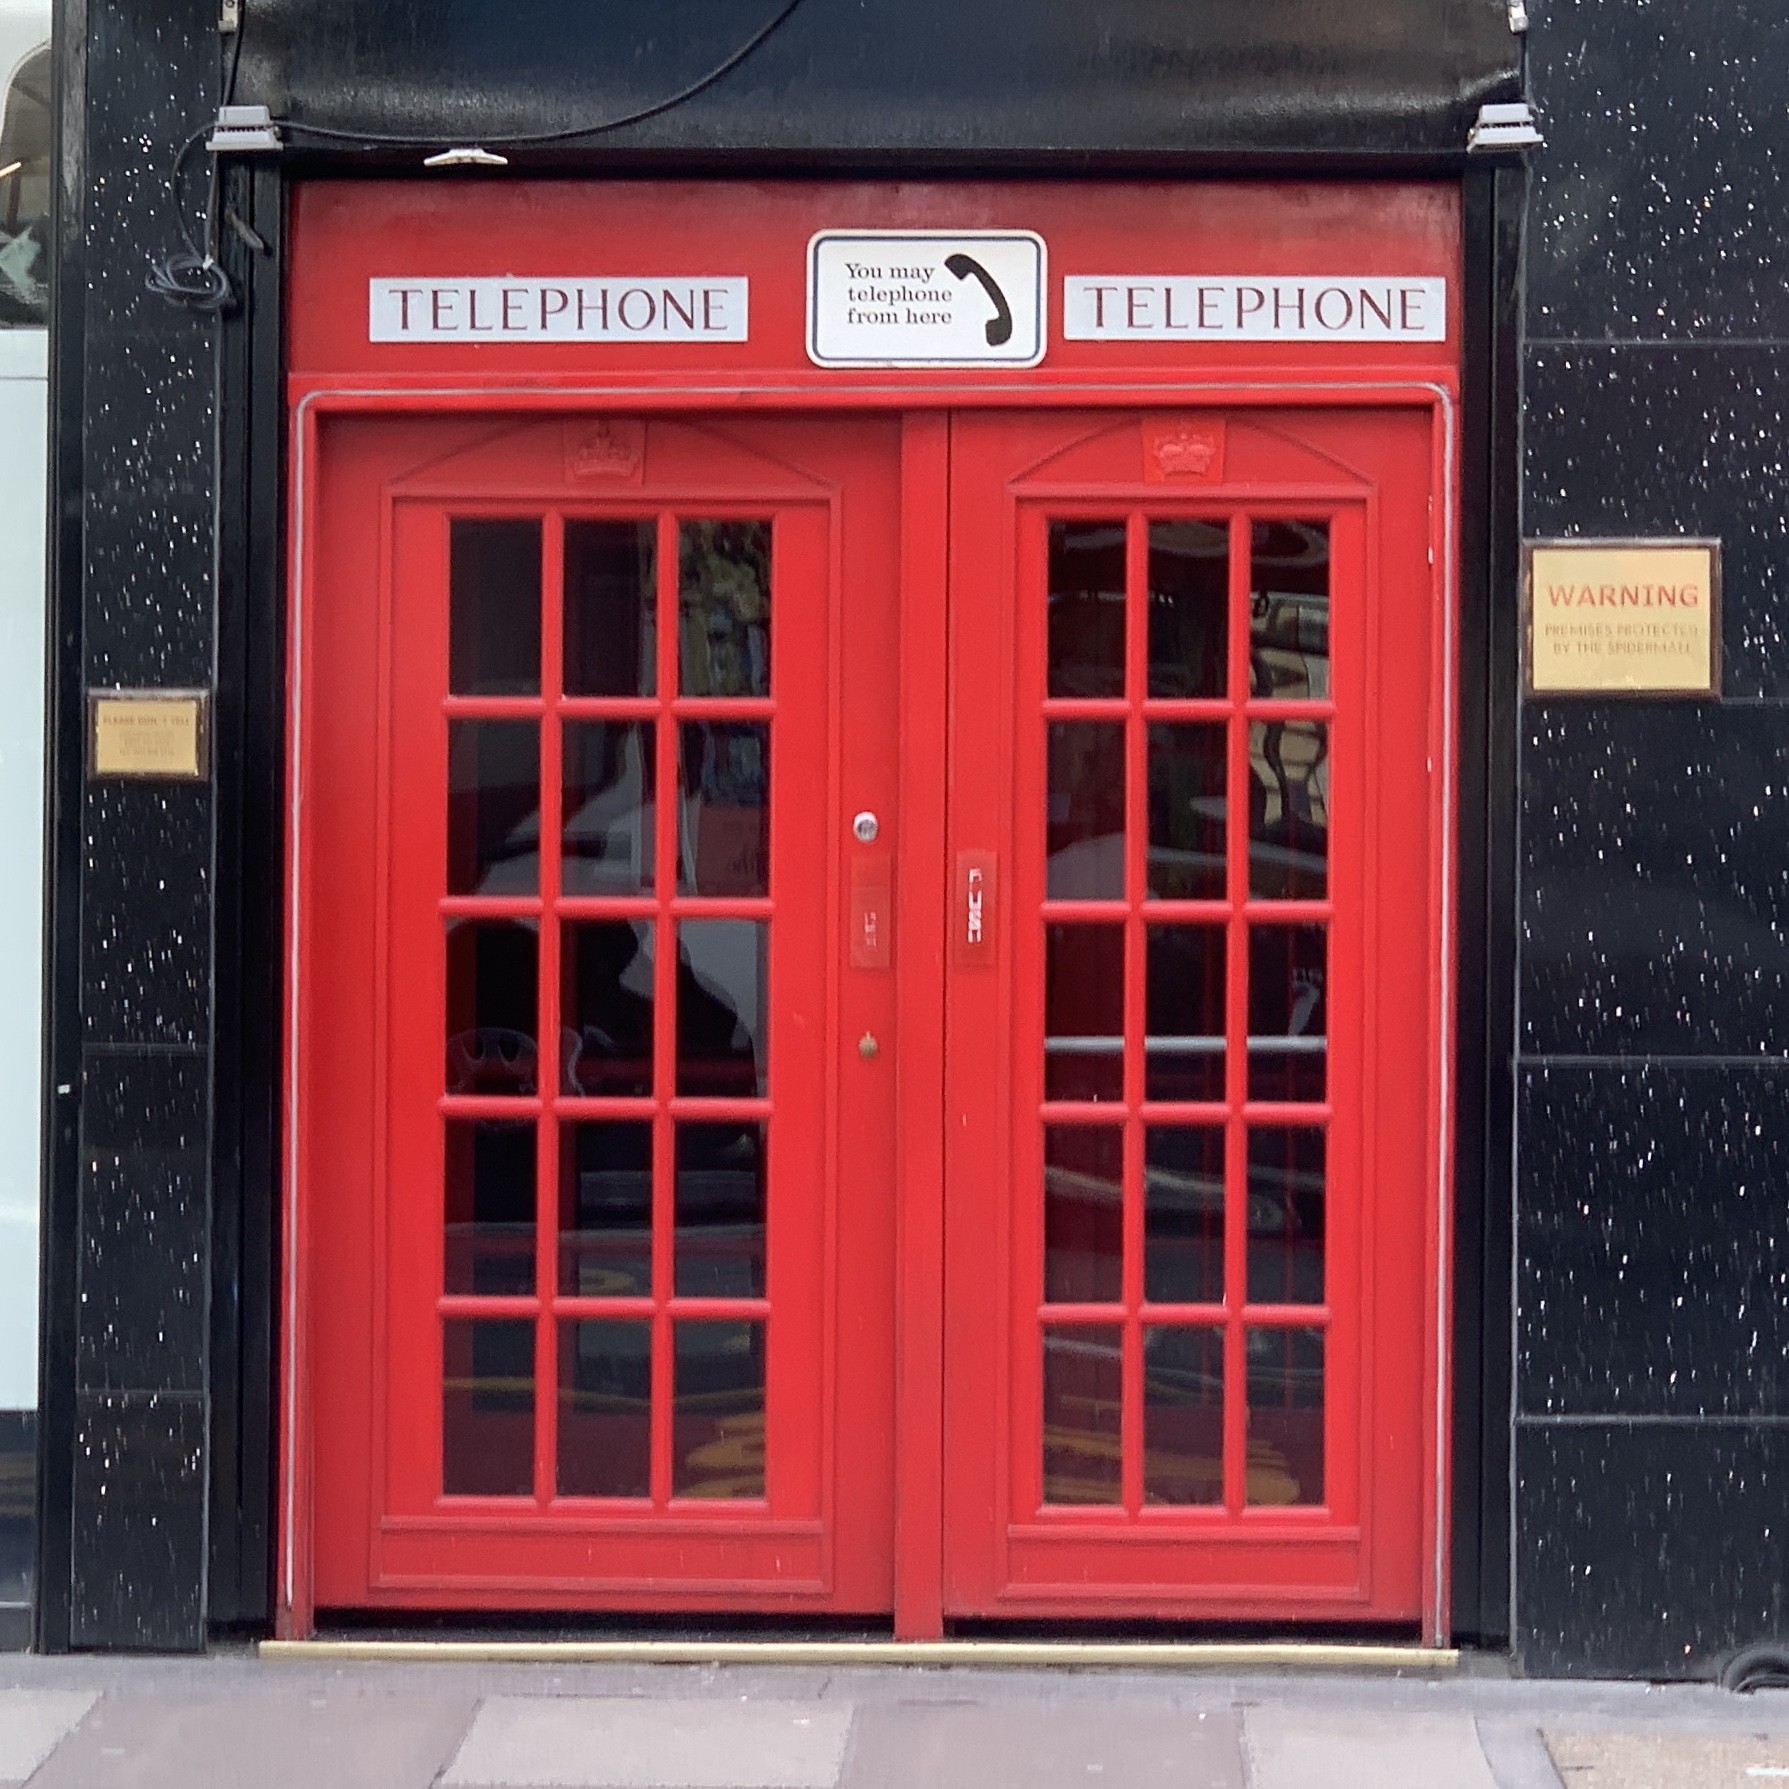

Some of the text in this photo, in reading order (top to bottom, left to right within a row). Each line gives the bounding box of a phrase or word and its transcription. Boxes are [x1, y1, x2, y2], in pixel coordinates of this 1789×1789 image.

[844, 263, 935, 284] You may
[848, 285, 953, 307] telephone
[388, 288, 730, 331] TELEPHONE
[848, 307, 953, 325] from here
[1083, 286, 1426, 330] TELEPHONE
[1547, 583, 1699, 608] WARNING
